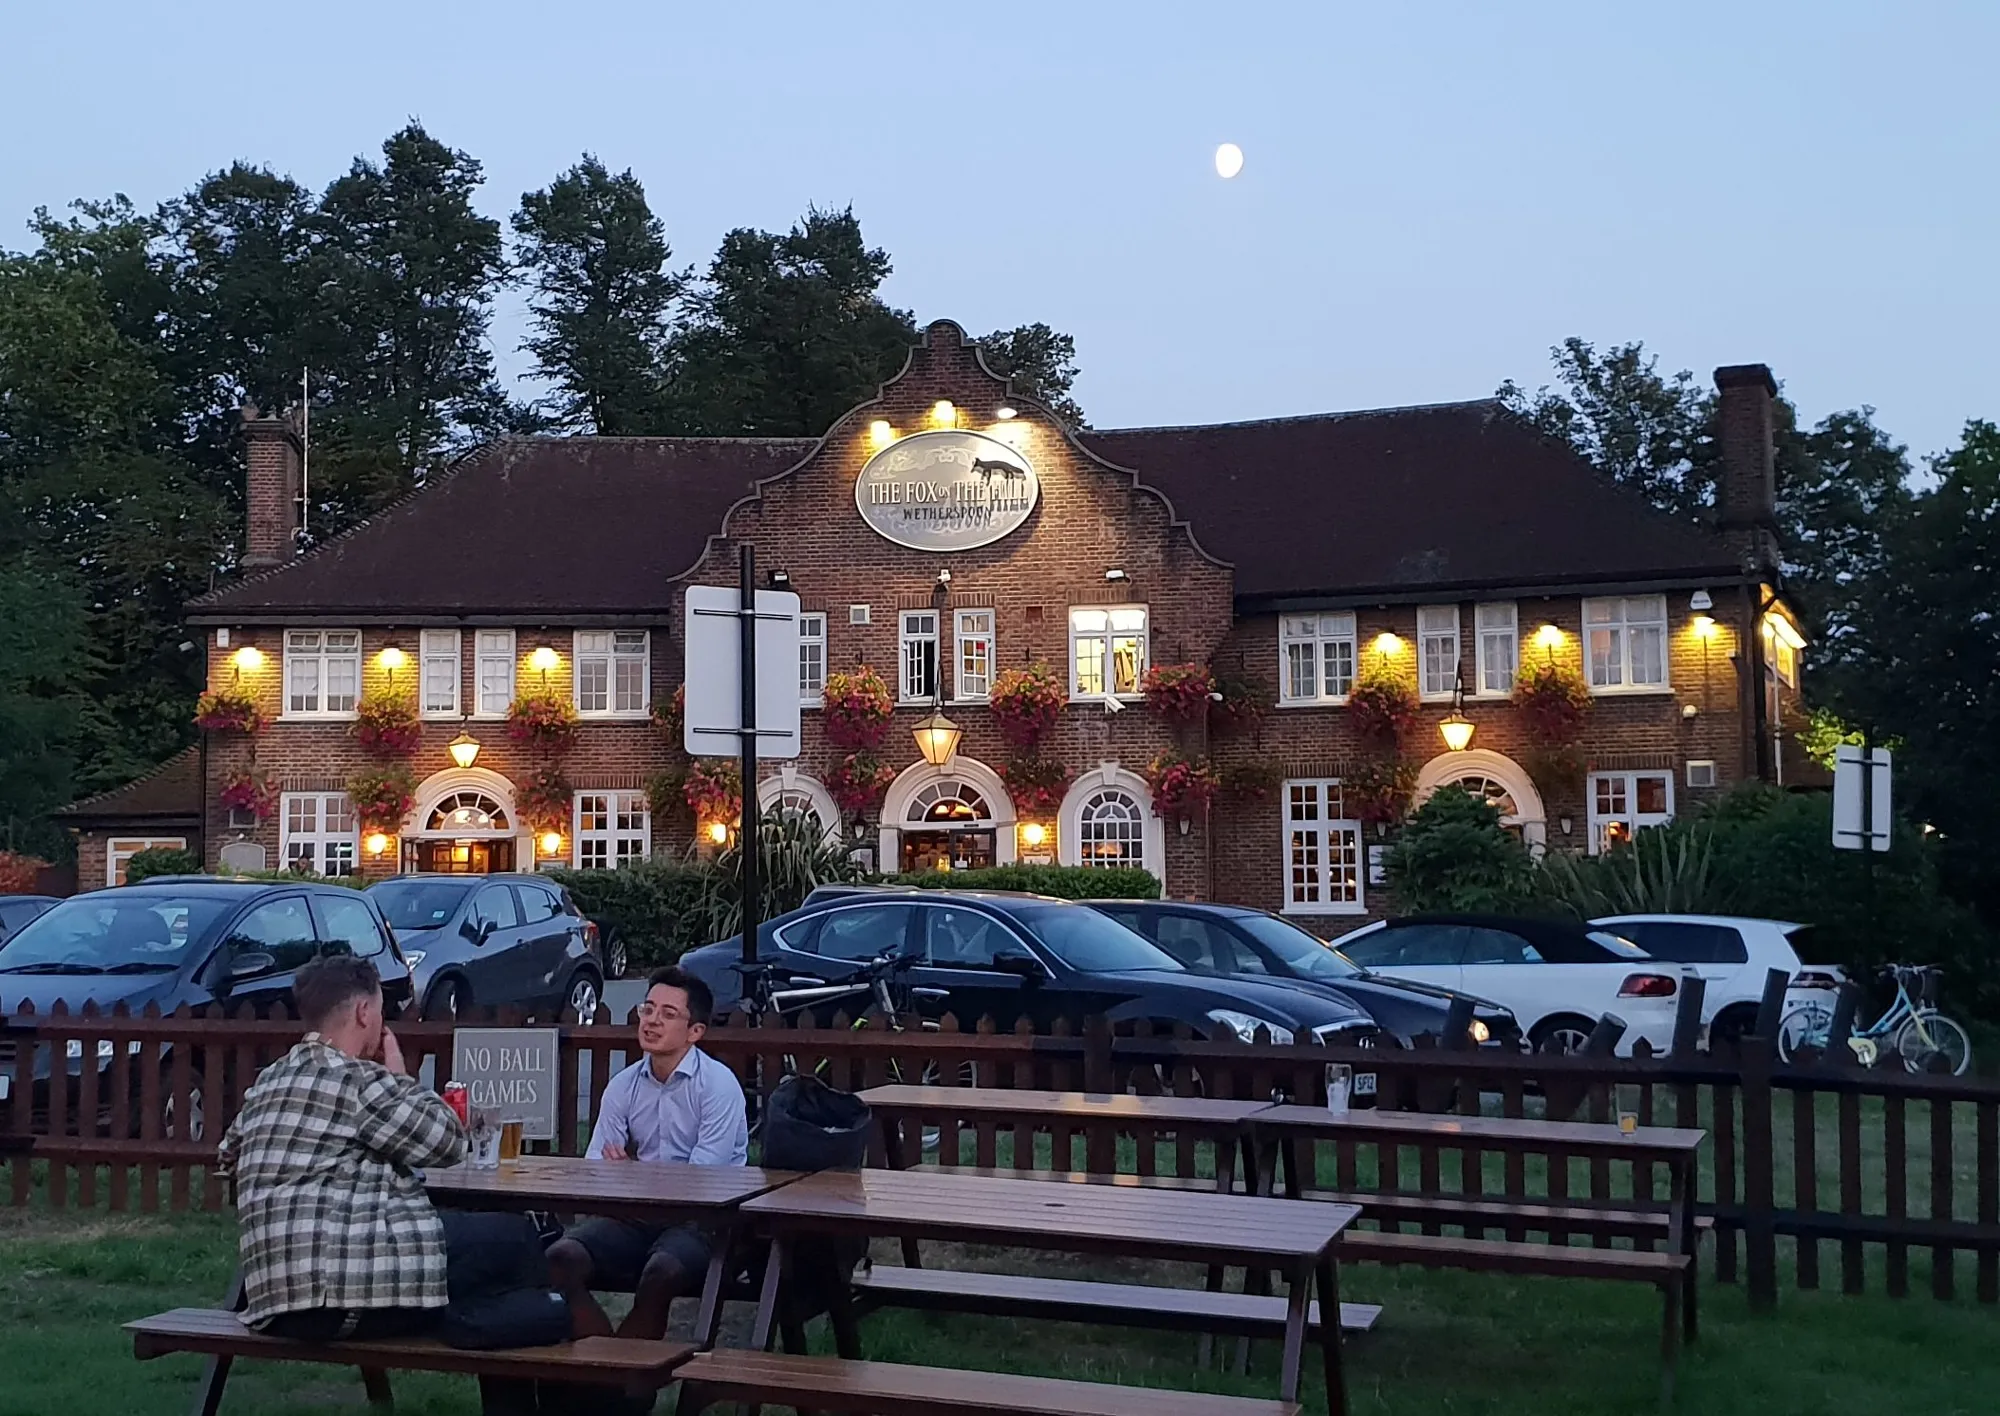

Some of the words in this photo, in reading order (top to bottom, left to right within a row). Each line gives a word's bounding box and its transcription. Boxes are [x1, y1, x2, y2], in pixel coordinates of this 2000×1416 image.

[868, 482, 901, 504] THE
[906, 481, 938, 503] FOX
[954, 480, 986, 502] THE
[903, 505, 992, 520] WETHERSPOON
[464, 1047, 491, 1072] NO
[500, 1047, 546, 1072] BALL
[471, 1079, 537, 1104] GAMES
